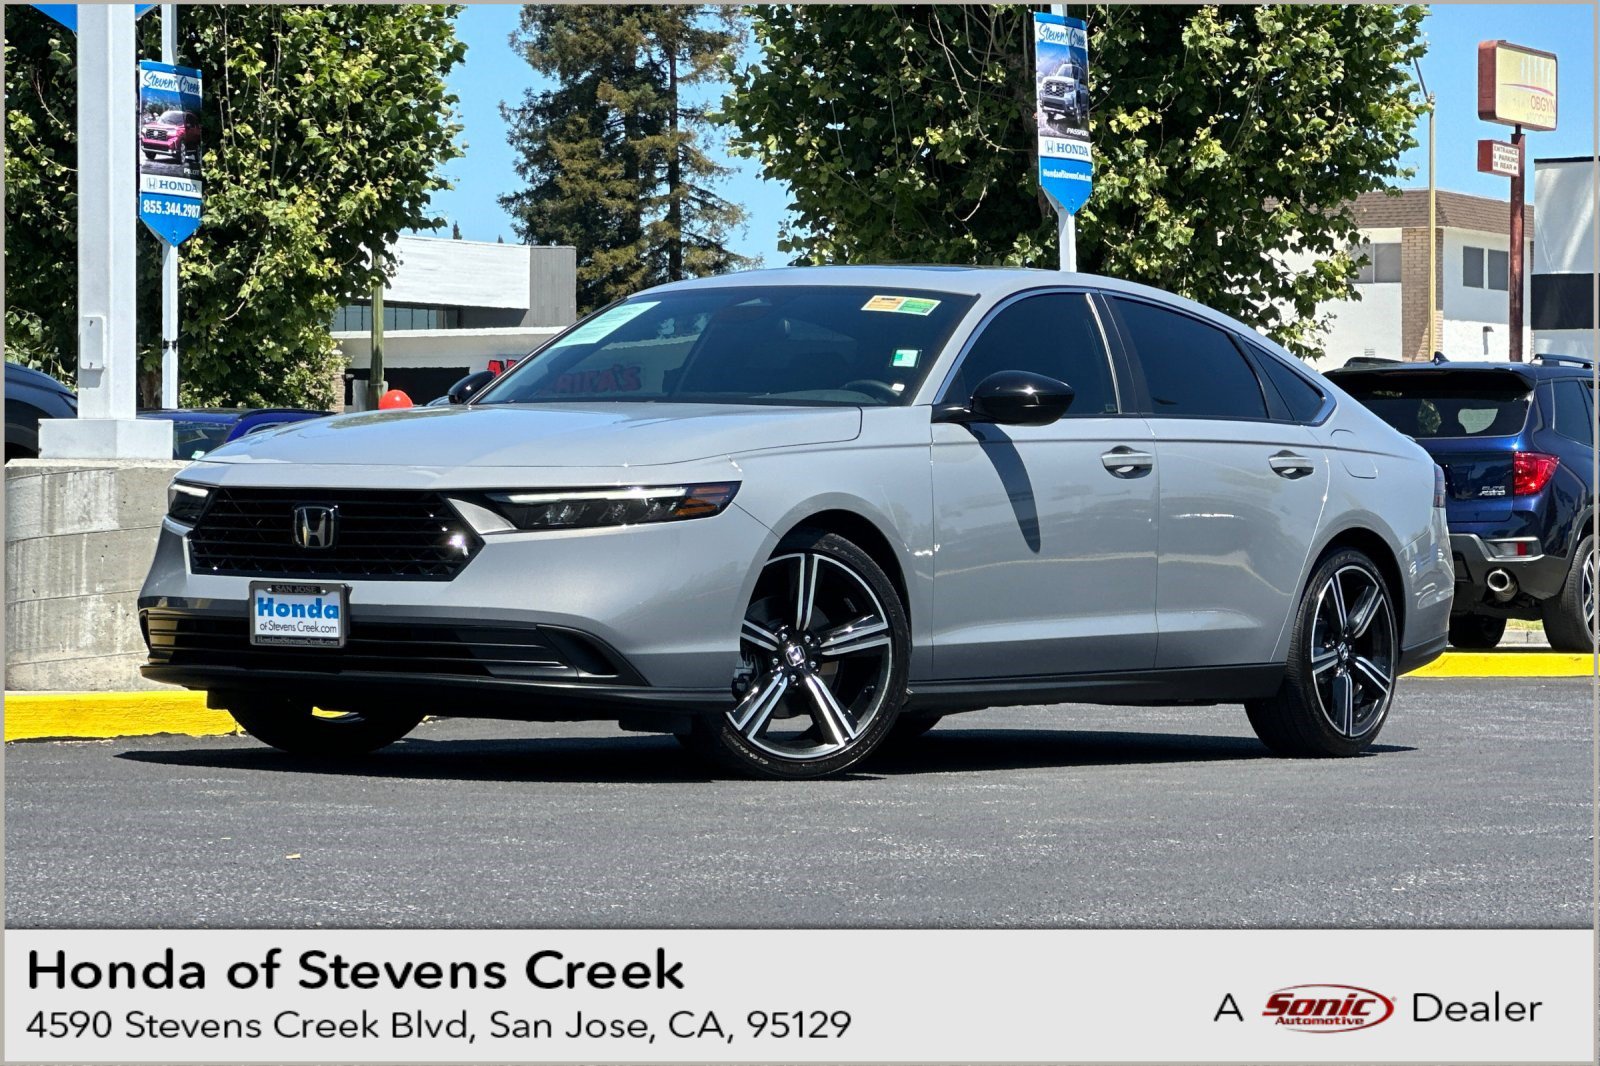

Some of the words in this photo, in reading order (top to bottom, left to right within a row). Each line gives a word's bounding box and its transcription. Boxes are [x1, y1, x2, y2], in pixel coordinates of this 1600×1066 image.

[1056, 143, 1089, 156] HONDA
[159, 179, 199, 194] HONDA
[143, 200, 201, 219] 855.344.2987
[275, 585, 293, 593] SAN
[294, 586, 317, 594] JOSE
[257, 597, 339, 619] Honda
[260, 622, 268, 631] of
